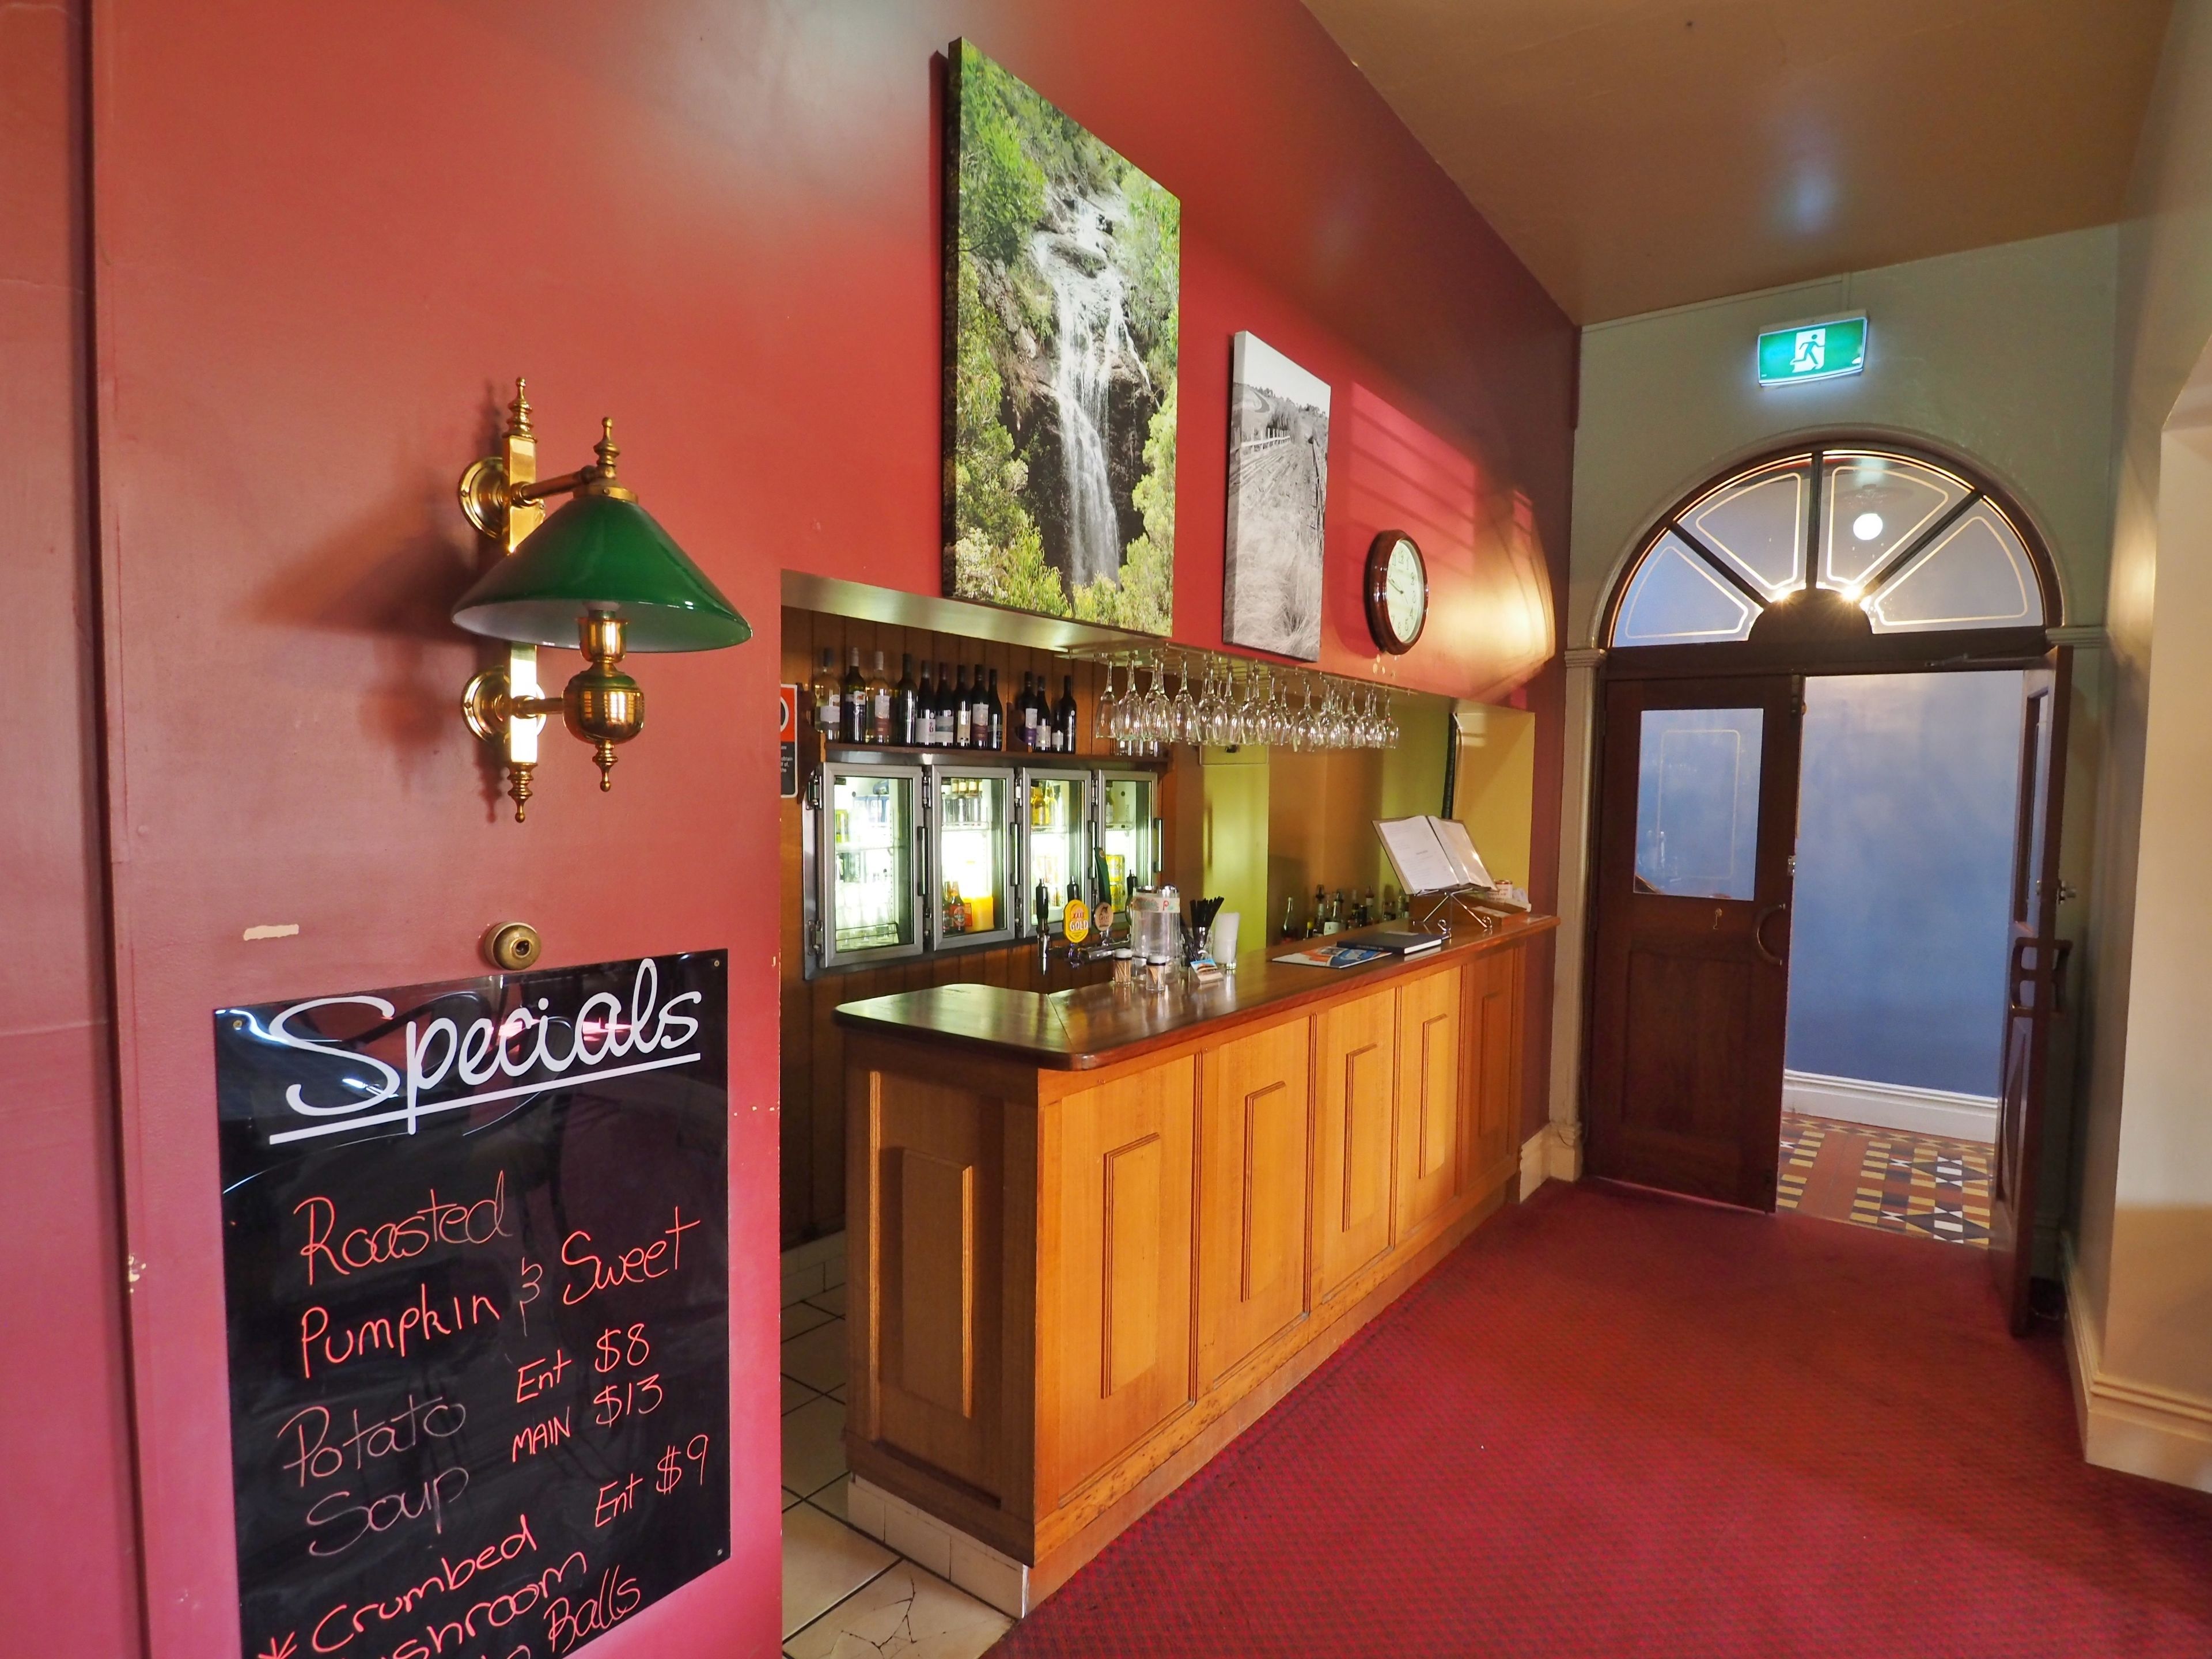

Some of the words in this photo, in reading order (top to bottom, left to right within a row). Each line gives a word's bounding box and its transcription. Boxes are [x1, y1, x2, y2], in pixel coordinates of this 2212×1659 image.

[1069, 920, 1089, 932] GOLD
[268, 957, 702, 1135] Specials
[293, 1170, 514, 1286] Roasted
[301, 1283, 500, 1379] Pumpkin
[561, 1206, 700, 1305] Sweet
[517, 1349, 572, 1403] Ent
[594, 1323, 649, 1373] $8
[276, 1394, 466, 1487] Potato
[513, 1406, 571, 1463] MAIN
[593, 1374, 663, 1429] $13
[306, 1467, 469, 1556] Soup
[595, 1473, 643, 1528] Ent
[656, 1434, 709, 1495] $9
[312, 1514, 537, 1653] Crumbed
[543, 1565, 641, 1654] Balls
